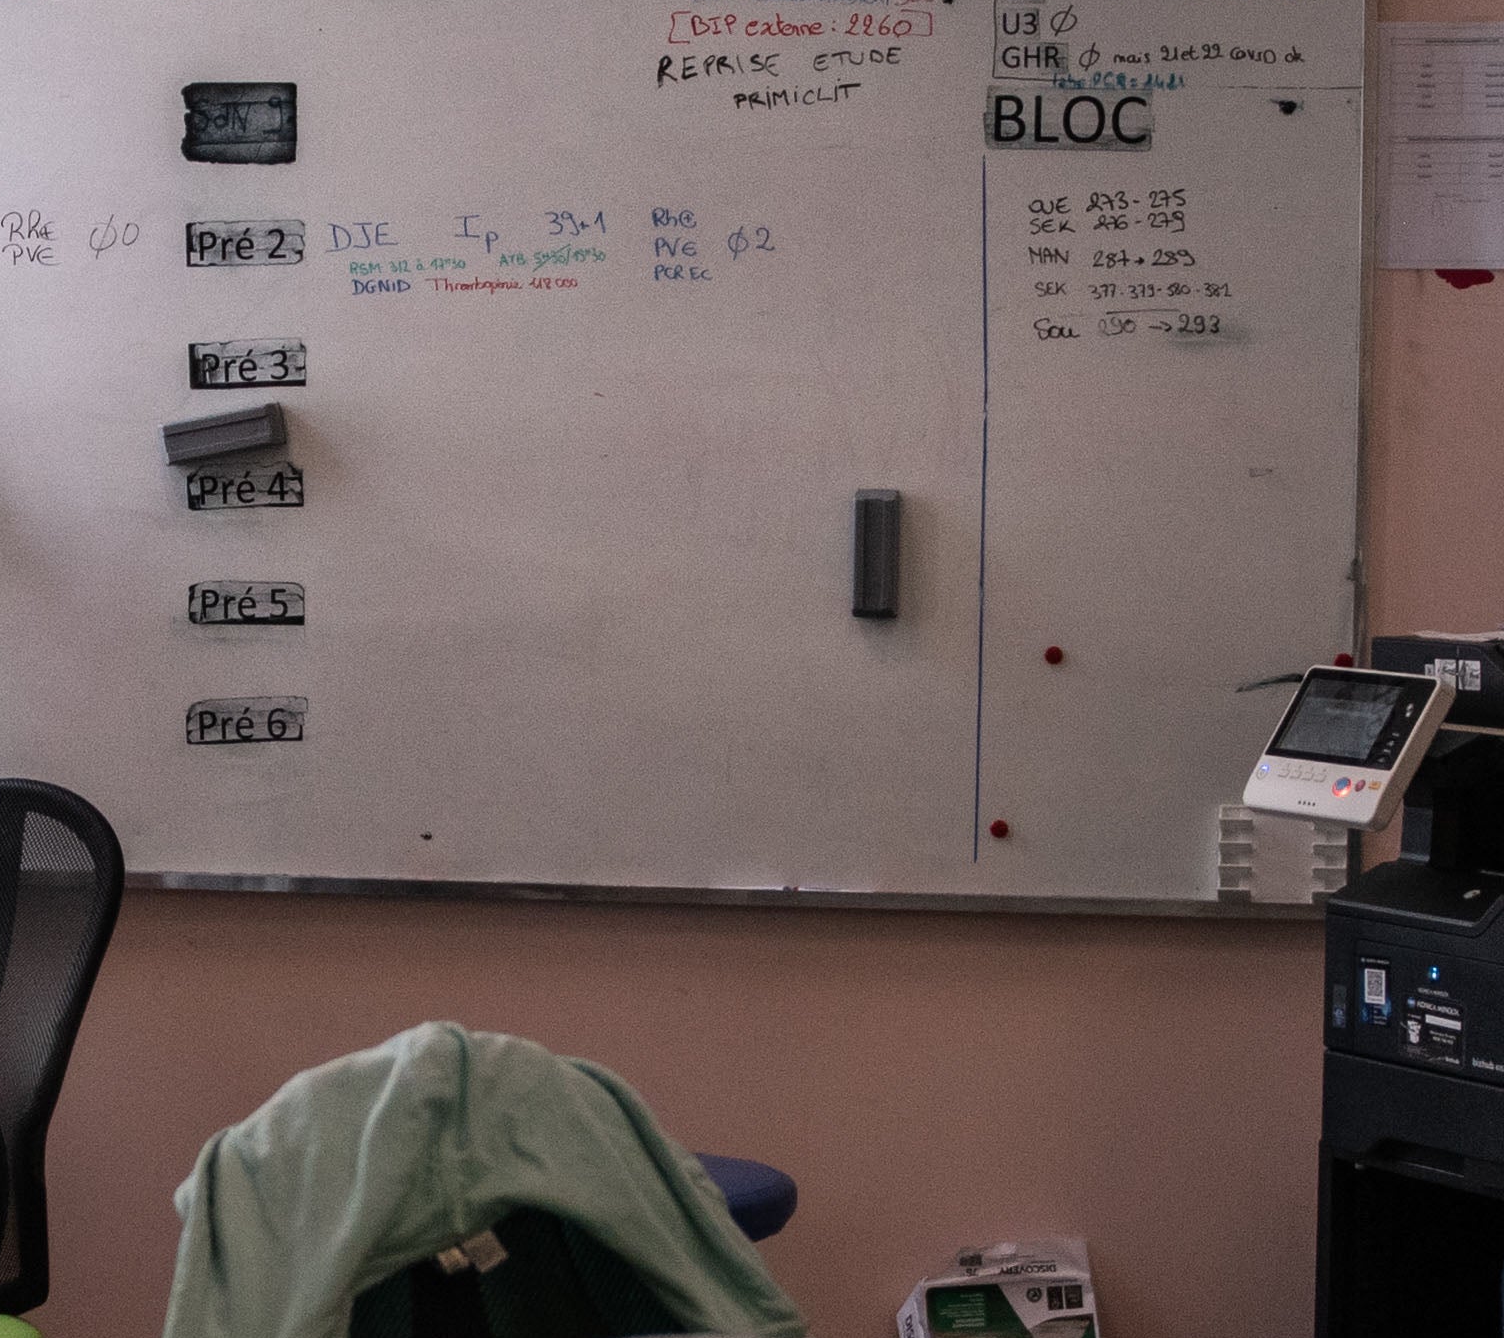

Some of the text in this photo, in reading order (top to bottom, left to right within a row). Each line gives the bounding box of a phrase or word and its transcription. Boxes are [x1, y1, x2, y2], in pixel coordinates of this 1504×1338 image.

[1002, 12, 1038, 36] U3
[656, 47, 902, 88] REPRISE ETUDE
[1002, 47, 1061, 70] GHR
[992, 94, 1150, 144] BLOC
[197, 227, 286, 261] Pré 2
[201, 349, 290, 382] Pré 3
[199, 472, 289, 505] Pré 4
[200, 587, 289, 621] Pré 5
[198, 707, 288, 740] Pré 6
